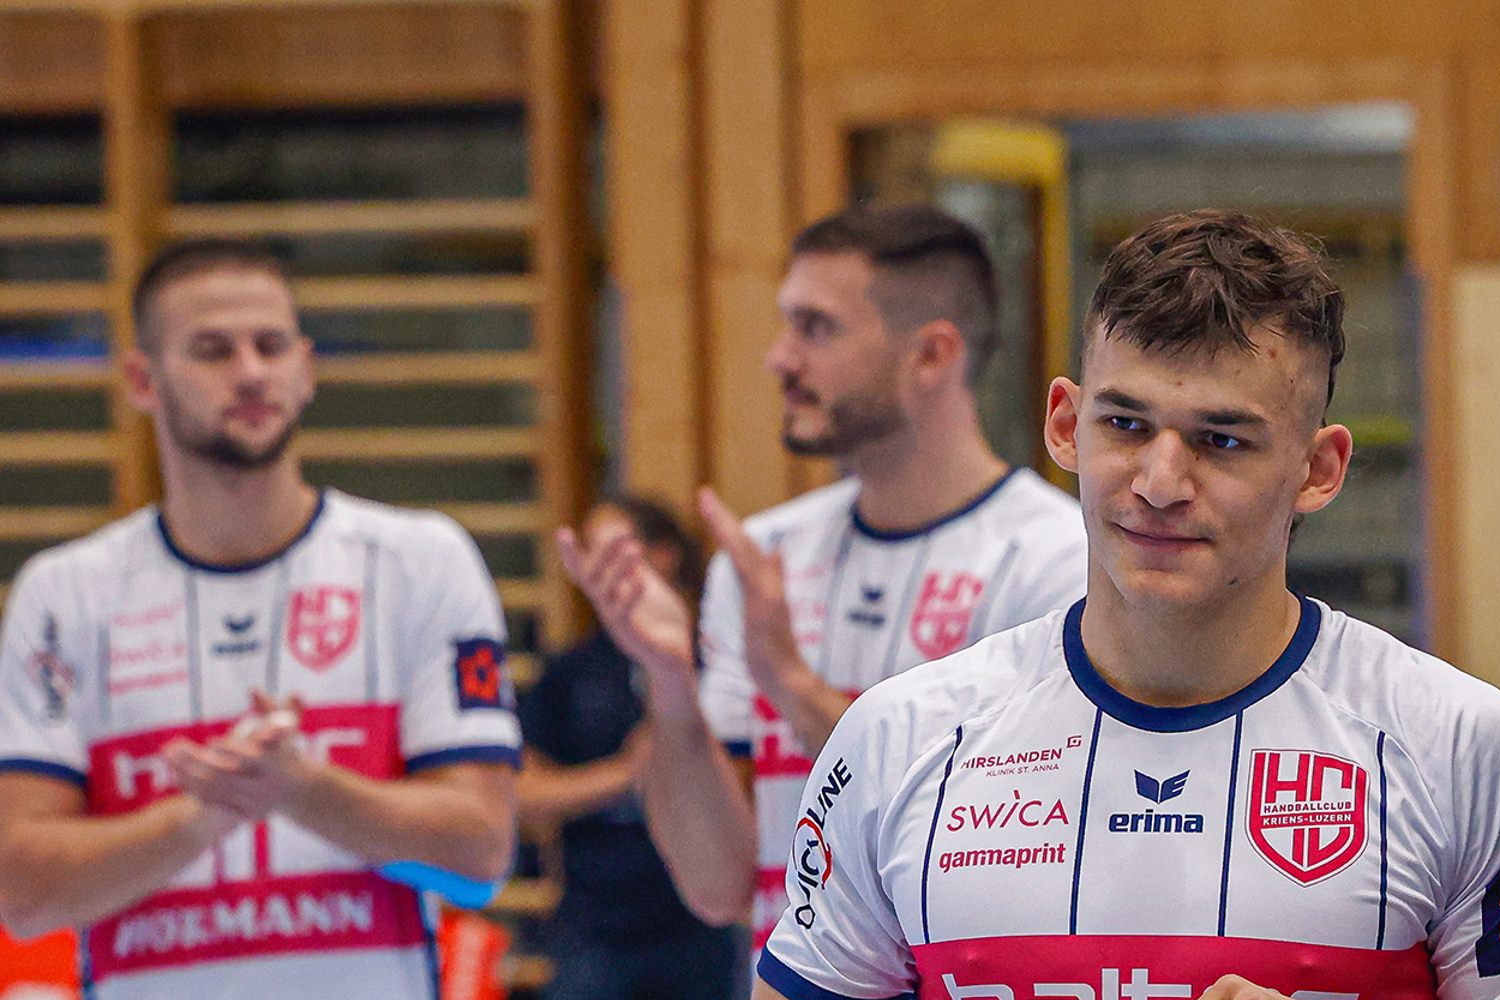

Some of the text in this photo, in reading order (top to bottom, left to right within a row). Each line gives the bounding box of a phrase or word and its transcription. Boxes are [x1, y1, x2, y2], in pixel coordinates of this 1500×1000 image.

[960, 748, 1062, 769] HIRSLANDEN
[986, 769, 1016, 777] KLINIK
[1032, 763, 1060, 772] ANNA
[946, 789, 1070, 831] SWICA
[1263, 801, 1352, 814] HANDBALLCLUB
[1108, 808, 1204, 834] erima
[1262, 813, 1353, 826] KRIENS-LUZERN
[939, 842, 1067, 873] gammaprint
